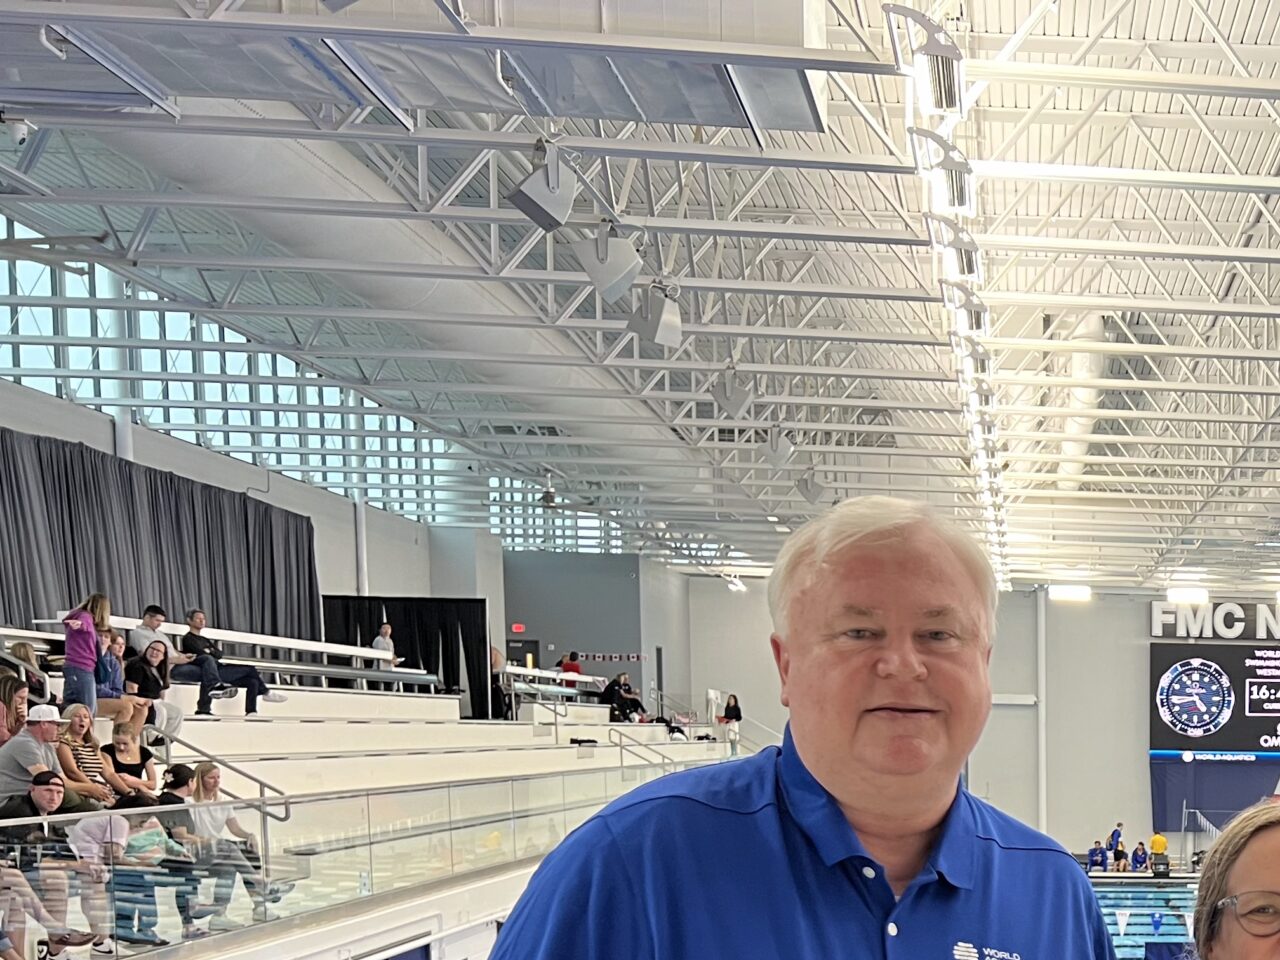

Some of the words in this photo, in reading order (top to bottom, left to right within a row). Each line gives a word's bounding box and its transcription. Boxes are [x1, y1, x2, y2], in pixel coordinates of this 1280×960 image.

[1151, 600, 1246, 639] FMC
[1254, 650, 1280, 658] WORLD
[982, 947, 1021, 960] WORLD
